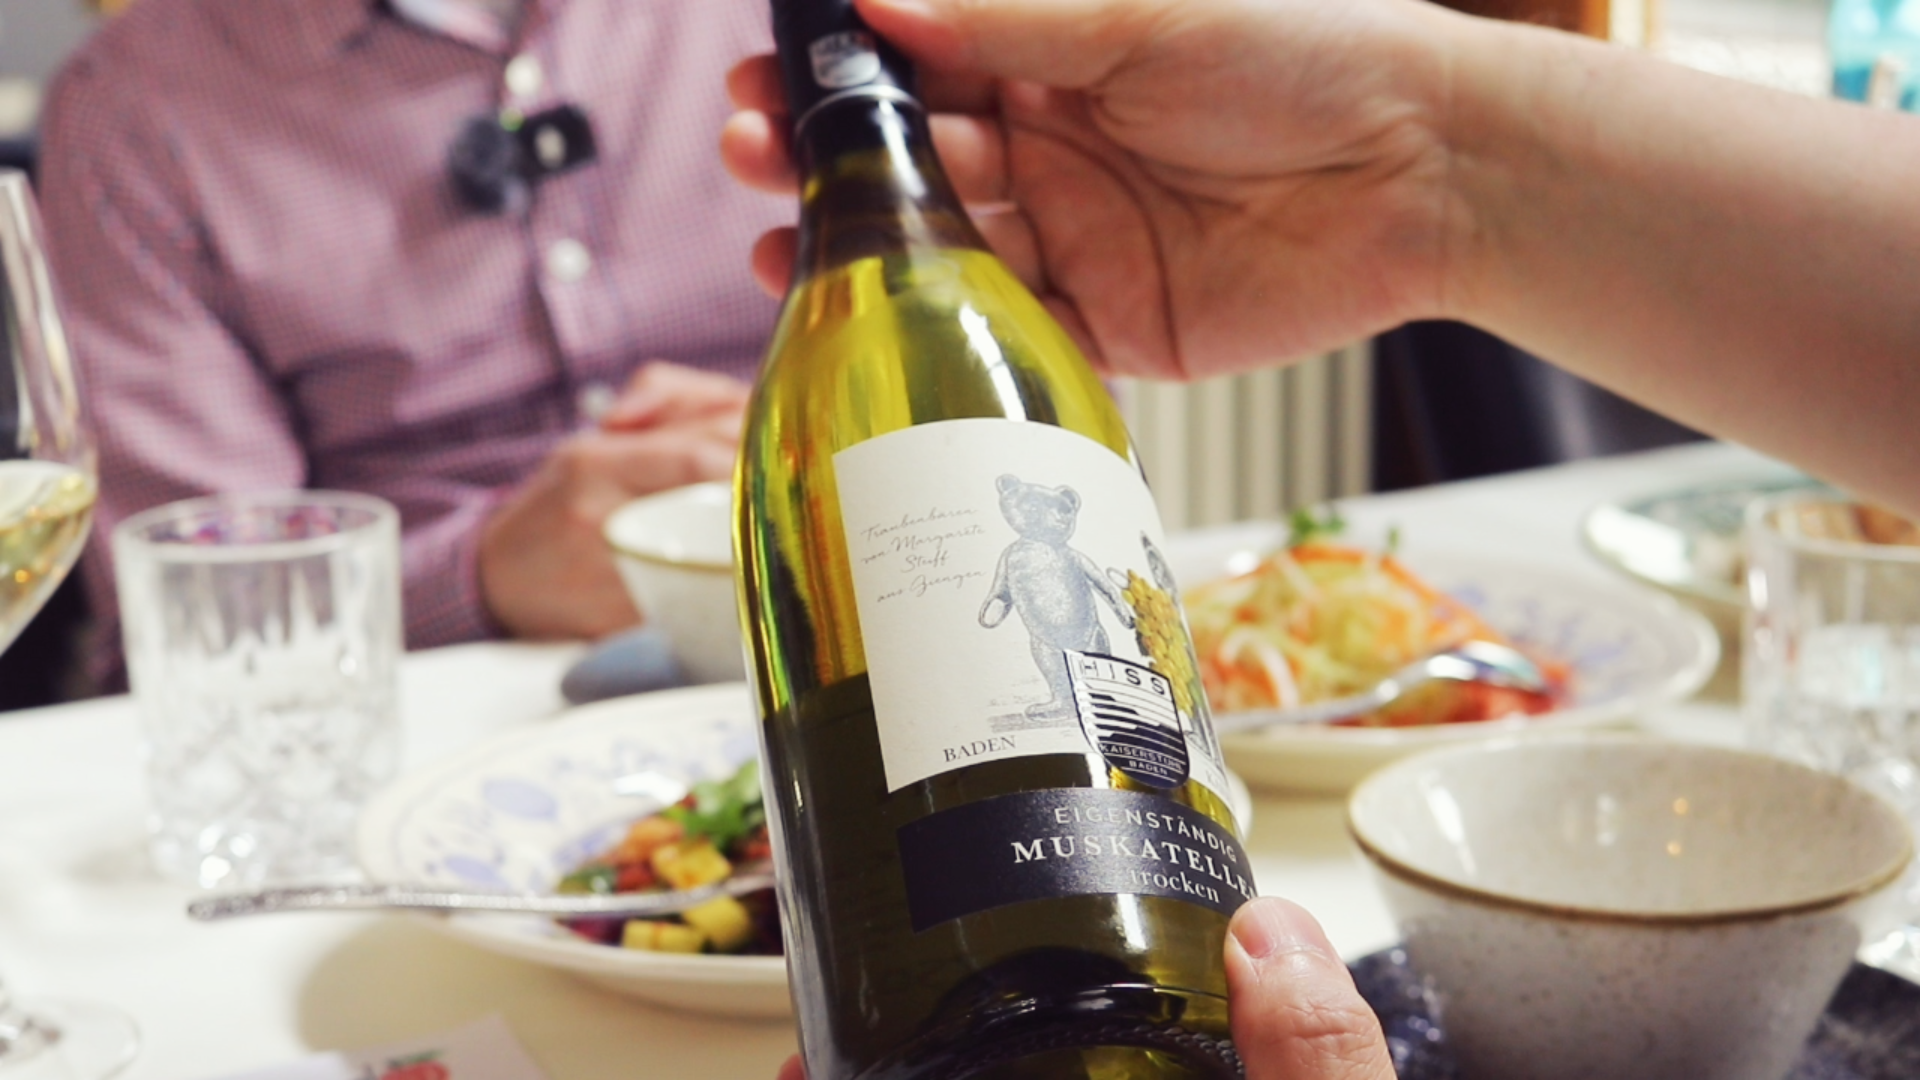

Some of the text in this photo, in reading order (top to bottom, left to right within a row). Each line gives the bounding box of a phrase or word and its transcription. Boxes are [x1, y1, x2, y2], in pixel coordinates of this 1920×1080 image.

[1079, 658, 1165, 696] HISS
[943, 735, 1016, 762] BADEN
[1129, 760, 1168, 776] BADEN
[1054, 807, 1237, 863] EIGENSTÄNDIG
[1130, 868, 1220, 904] trocken
